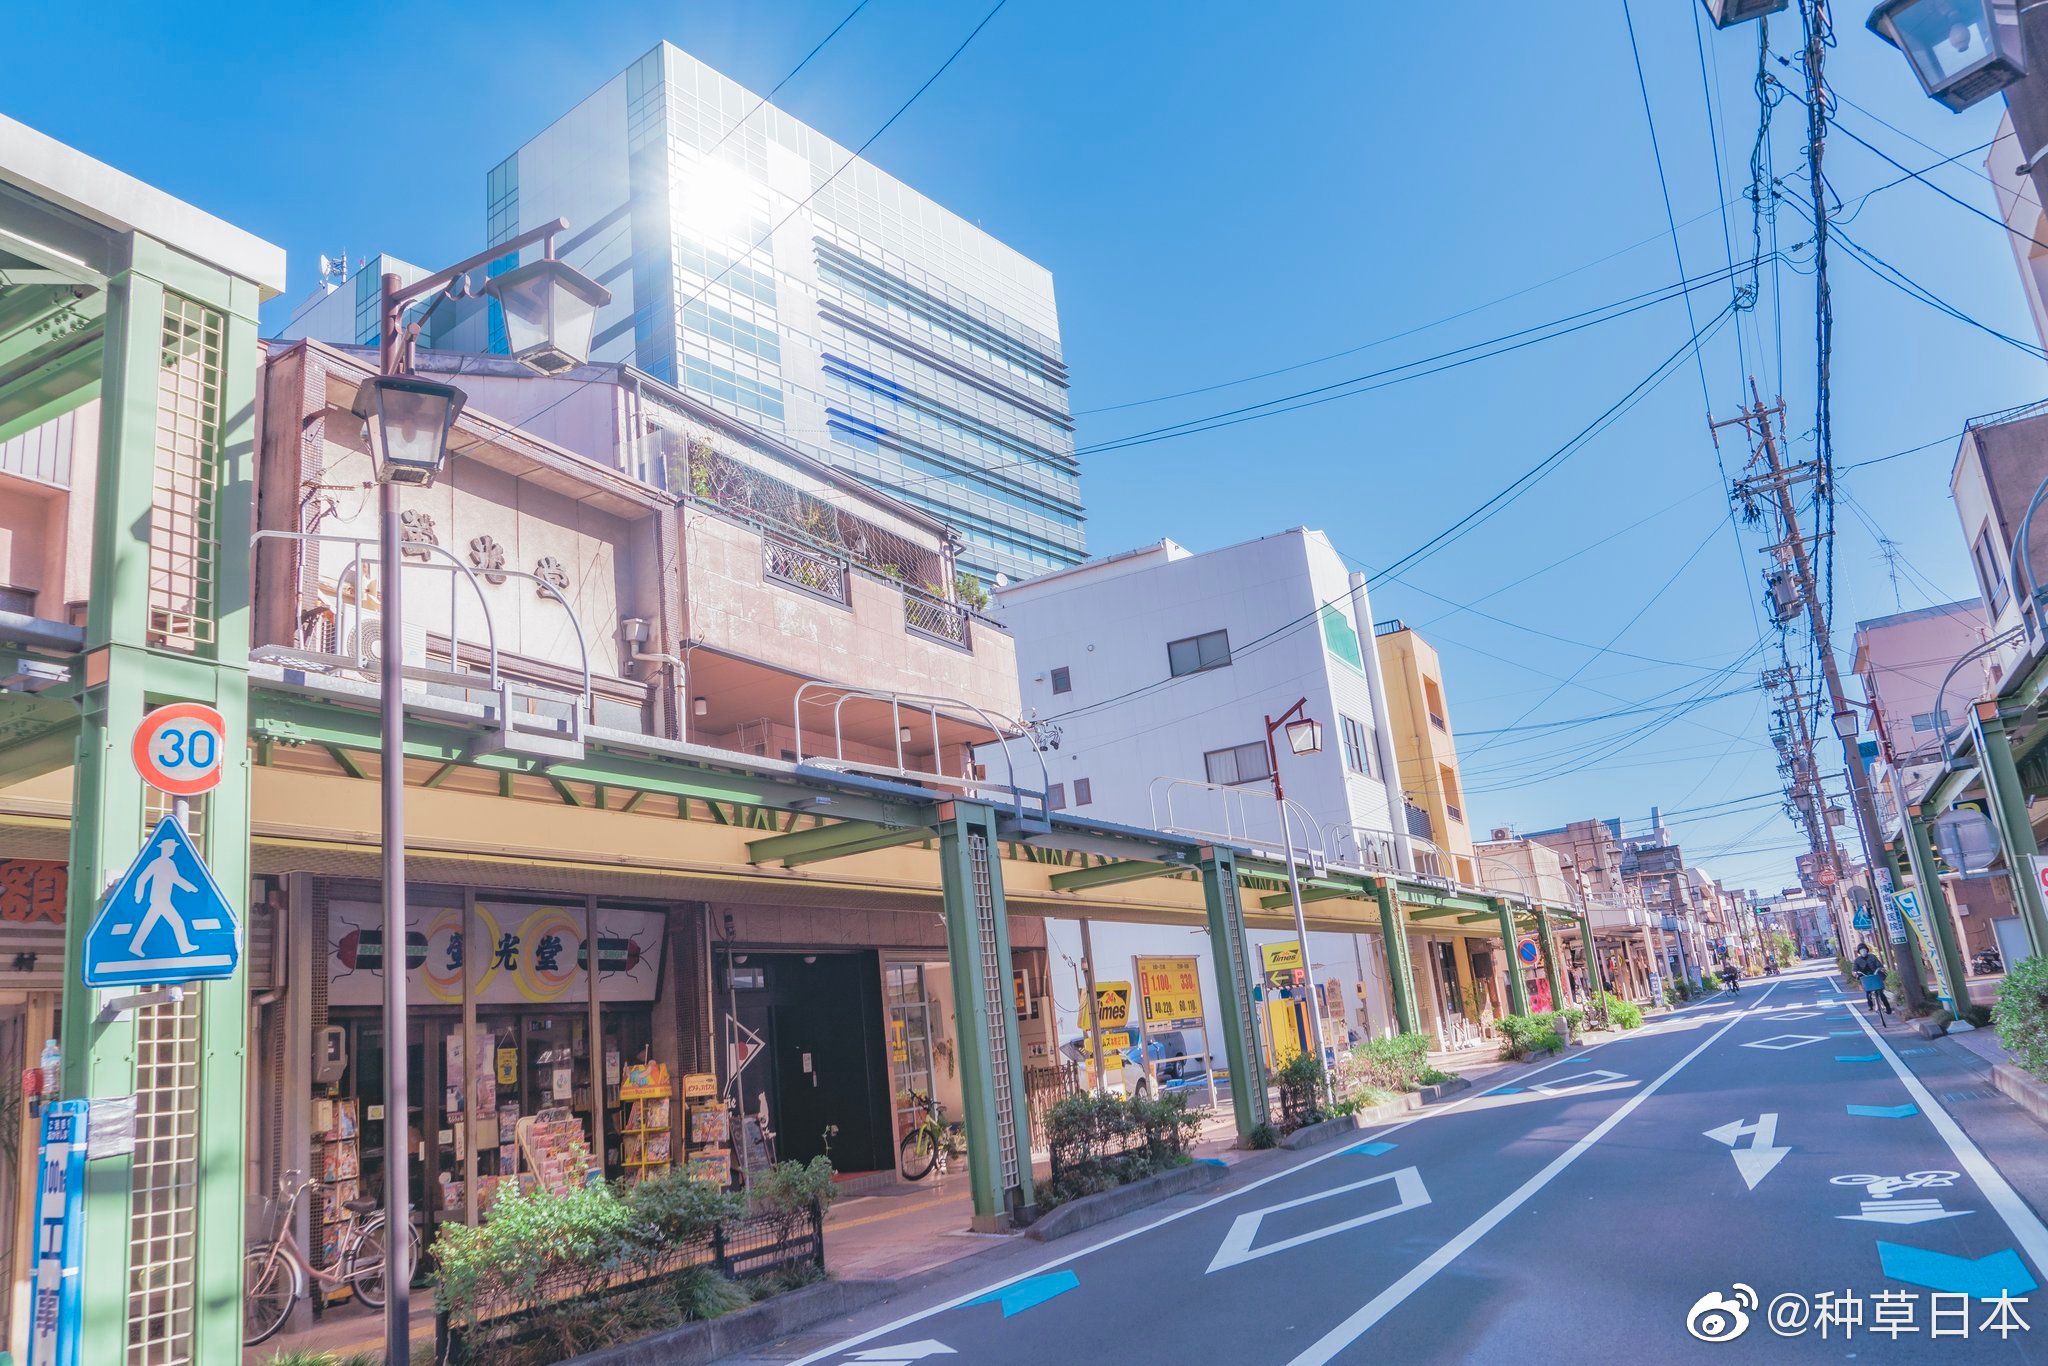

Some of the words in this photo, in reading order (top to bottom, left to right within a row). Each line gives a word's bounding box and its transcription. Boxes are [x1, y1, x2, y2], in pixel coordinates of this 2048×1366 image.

[159, 729, 215, 768] 30
[1294, 969, 1304, 984] P
[1098, 1005, 1126, 1020] imes
[35, 1217, 65, 1366] 工事
